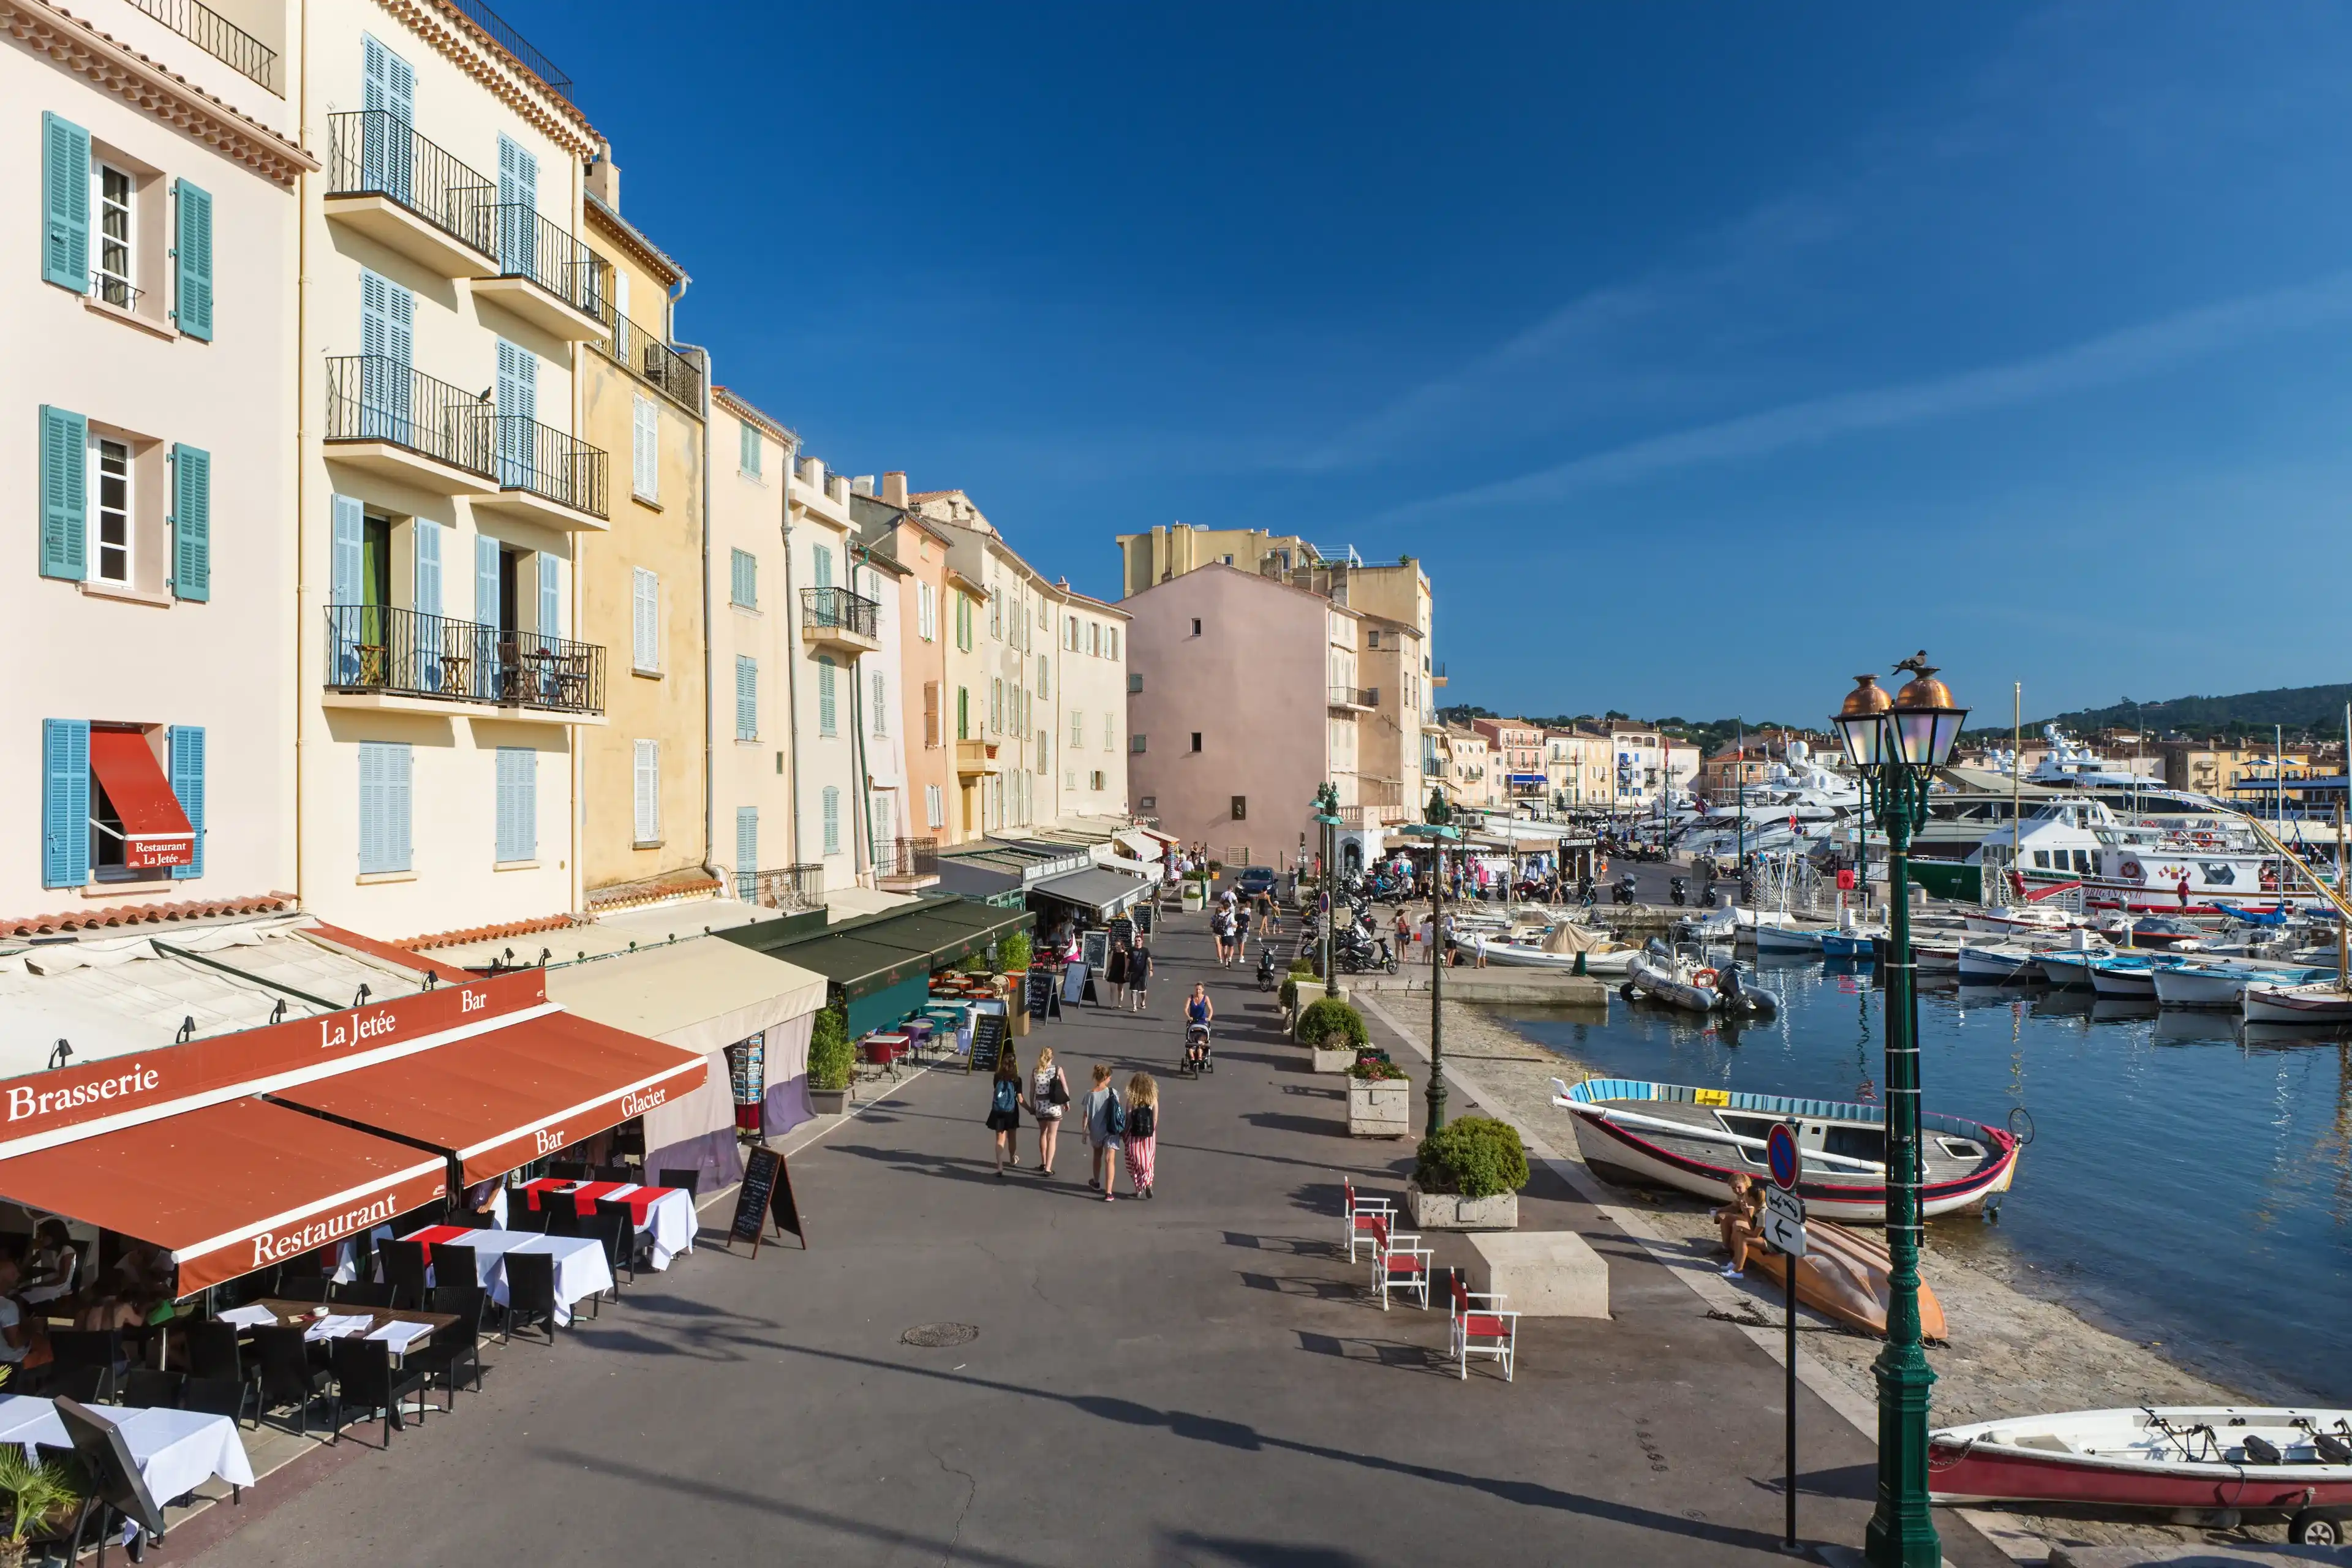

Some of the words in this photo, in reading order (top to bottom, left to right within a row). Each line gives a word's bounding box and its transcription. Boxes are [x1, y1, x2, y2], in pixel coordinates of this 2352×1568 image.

[135, 842, 186, 853] Restaurant
[143, 854, 156, 865] La
[156, 853, 179, 866] Jetée
[1025, 864, 1043, 880] RISTORANTE
[1044, 862, 1056, 876] ITALIANO
[6, 1063, 159, 1122] Brasserie
[320, 1020, 345, 1048] La
[350, 1009, 396, 1047] Jetée
[461, 989, 487, 1013] Bar
[252, 1193, 397, 1268] Restaurant
[534, 1129, 565, 1155] Bar
[621, 1087, 666, 1118] Glacier
